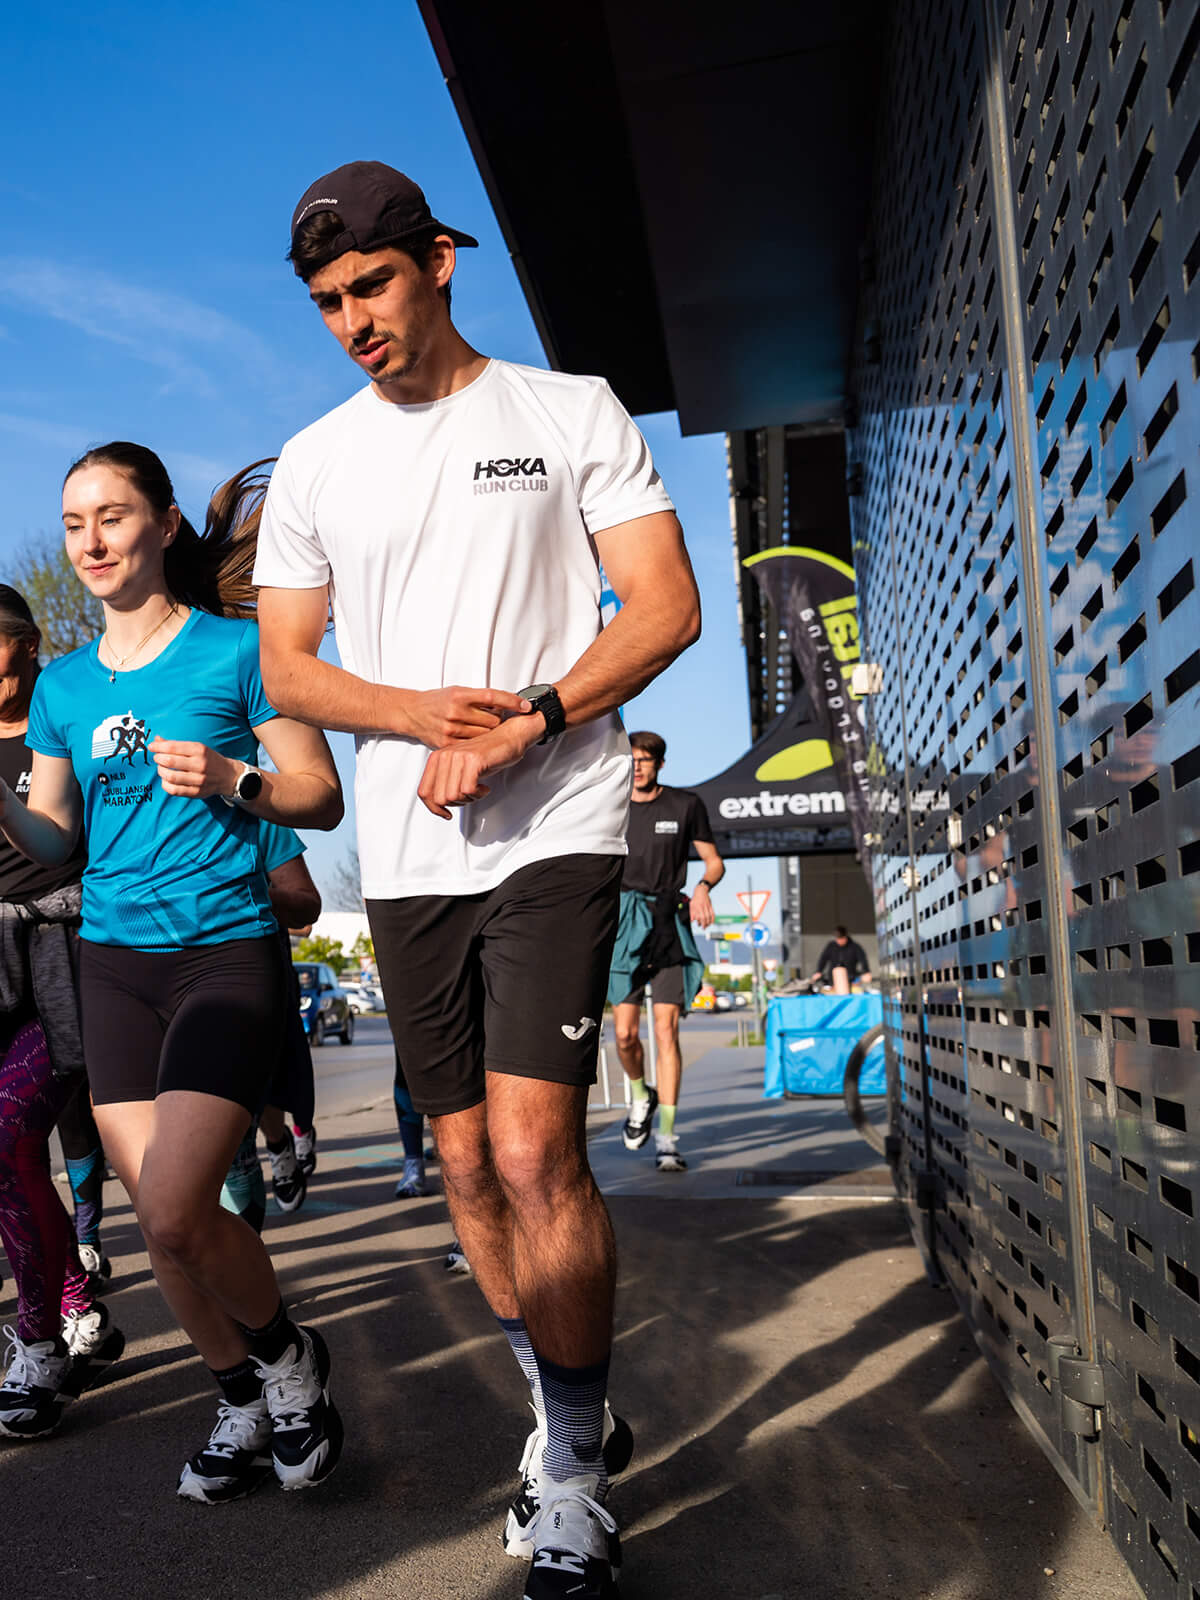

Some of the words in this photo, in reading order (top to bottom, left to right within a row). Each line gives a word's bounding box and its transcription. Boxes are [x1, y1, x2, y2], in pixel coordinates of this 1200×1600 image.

[473, 458, 547, 480] HOKA
[473, 481, 506, 496] RUN
[508, 480, 548, 492] CLUB
[15, 784, 31, 793] RU
[104, 793, 153, 807] MARATON
[719, 790, 847, 819] extrem
